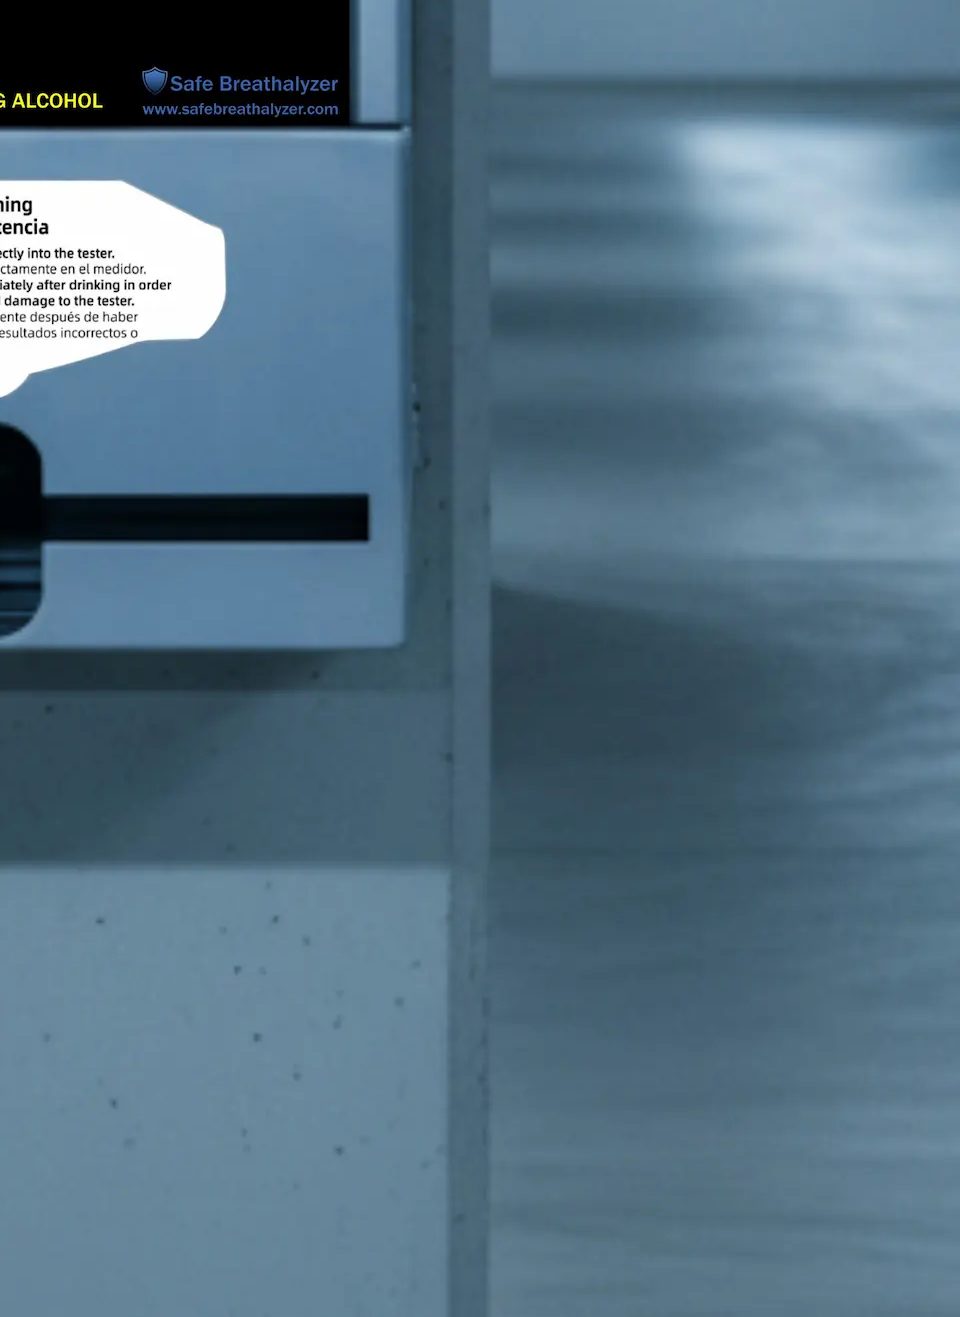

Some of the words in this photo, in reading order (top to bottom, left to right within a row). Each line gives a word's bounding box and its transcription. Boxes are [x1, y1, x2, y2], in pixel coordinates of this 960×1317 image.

[170, 75, 214, 92] Safe
[219, 75, 339, 95] Breathalyzer
[11, 92, 104, 109] ALCOHOL
[142, 102, 339, 118] www.safebreathalyzer.com
[27, 247, 51, 259] into
[53, 247, 75, 259] the
[76, 248, 115, 259] tester.
[60, 265, 76, 275] en
[78, 263, 90, 275] el
[93, 263, 147, 275] medidor.
[36, 279, 66, 291] after
[68, 279, 120, 293] drinking
[123, 279, 136, 291] in
[138, 279, 172, 291] order
[4, 294, 56, 309] damage
[58, 295, 71, 307] to
[73, 294, 94, 307] the
[97, 295, 135, 307] tester.
[29, 311, 81, 325] después
[83, 311, 100, 323] de
[102, 311, 139, 323] haber
[60, 327, 127, 339] incorrectos
[130, 329, 139, 339] o
